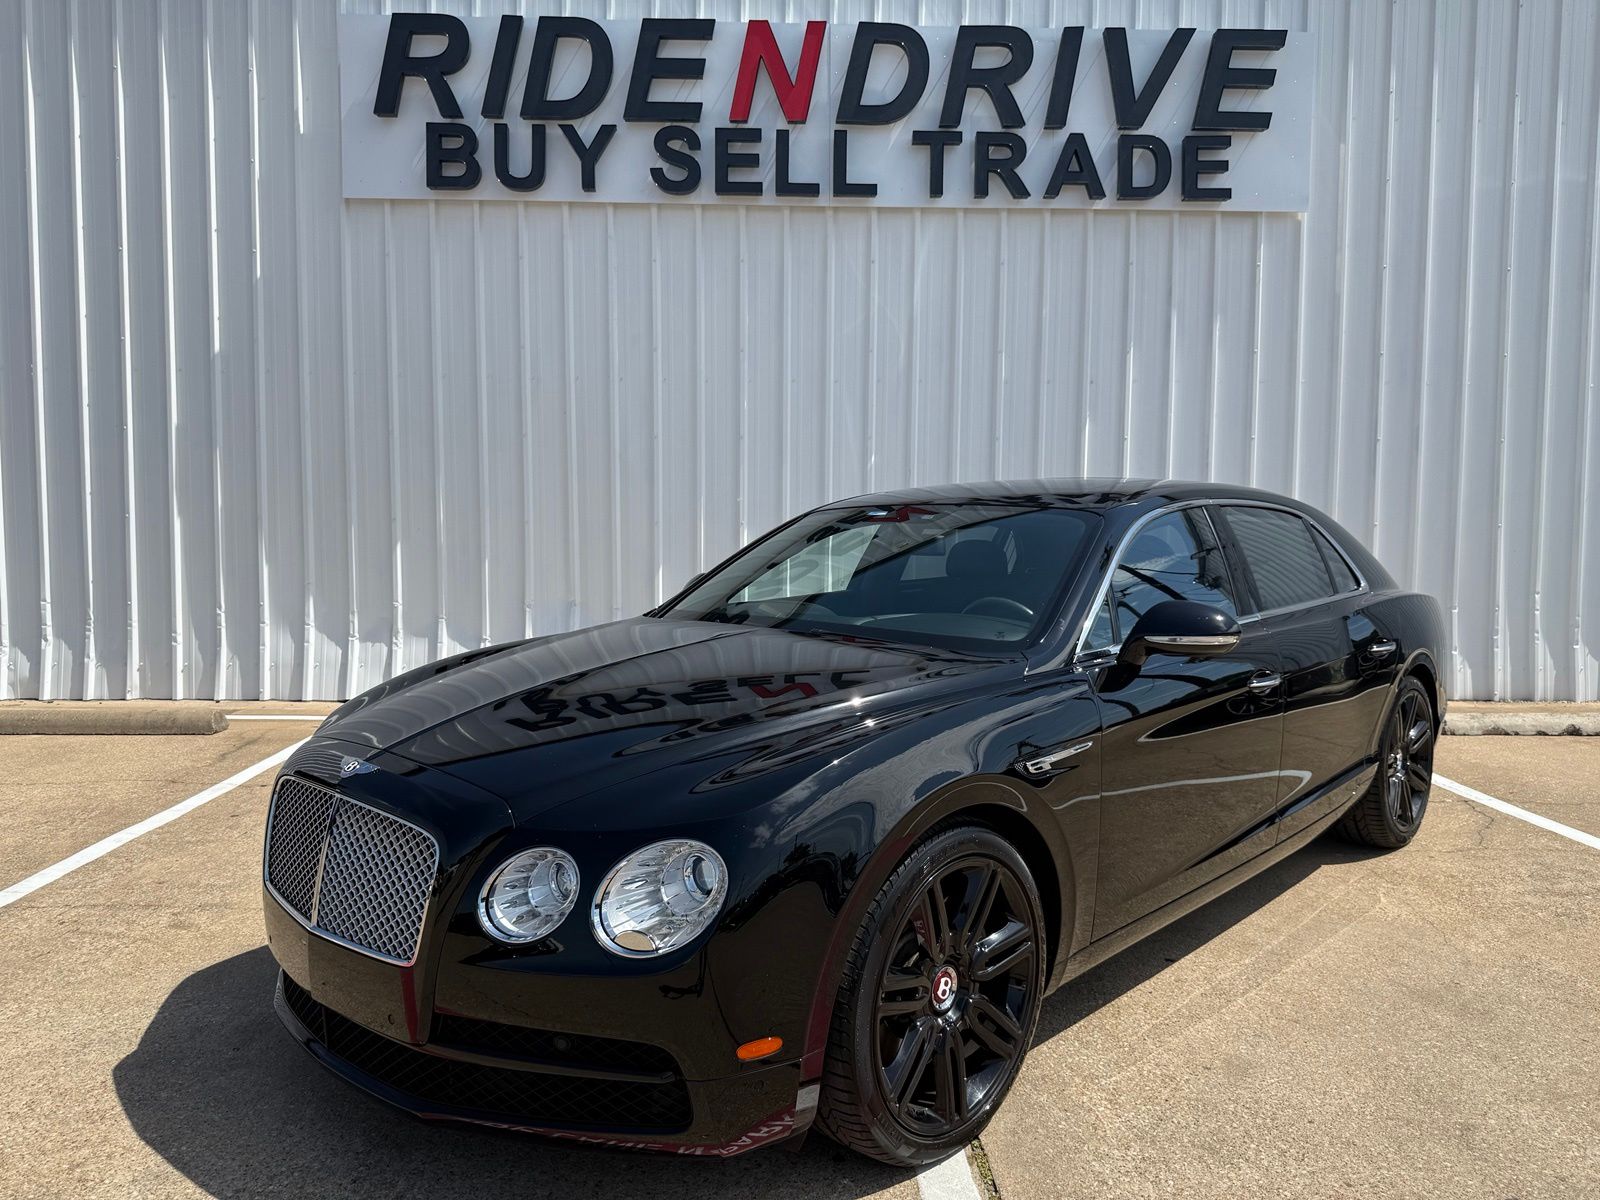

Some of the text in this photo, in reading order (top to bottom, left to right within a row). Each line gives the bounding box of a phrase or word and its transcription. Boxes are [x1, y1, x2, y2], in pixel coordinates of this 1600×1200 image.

[425, 121, 1232, 202] BUY SELL TRADE
